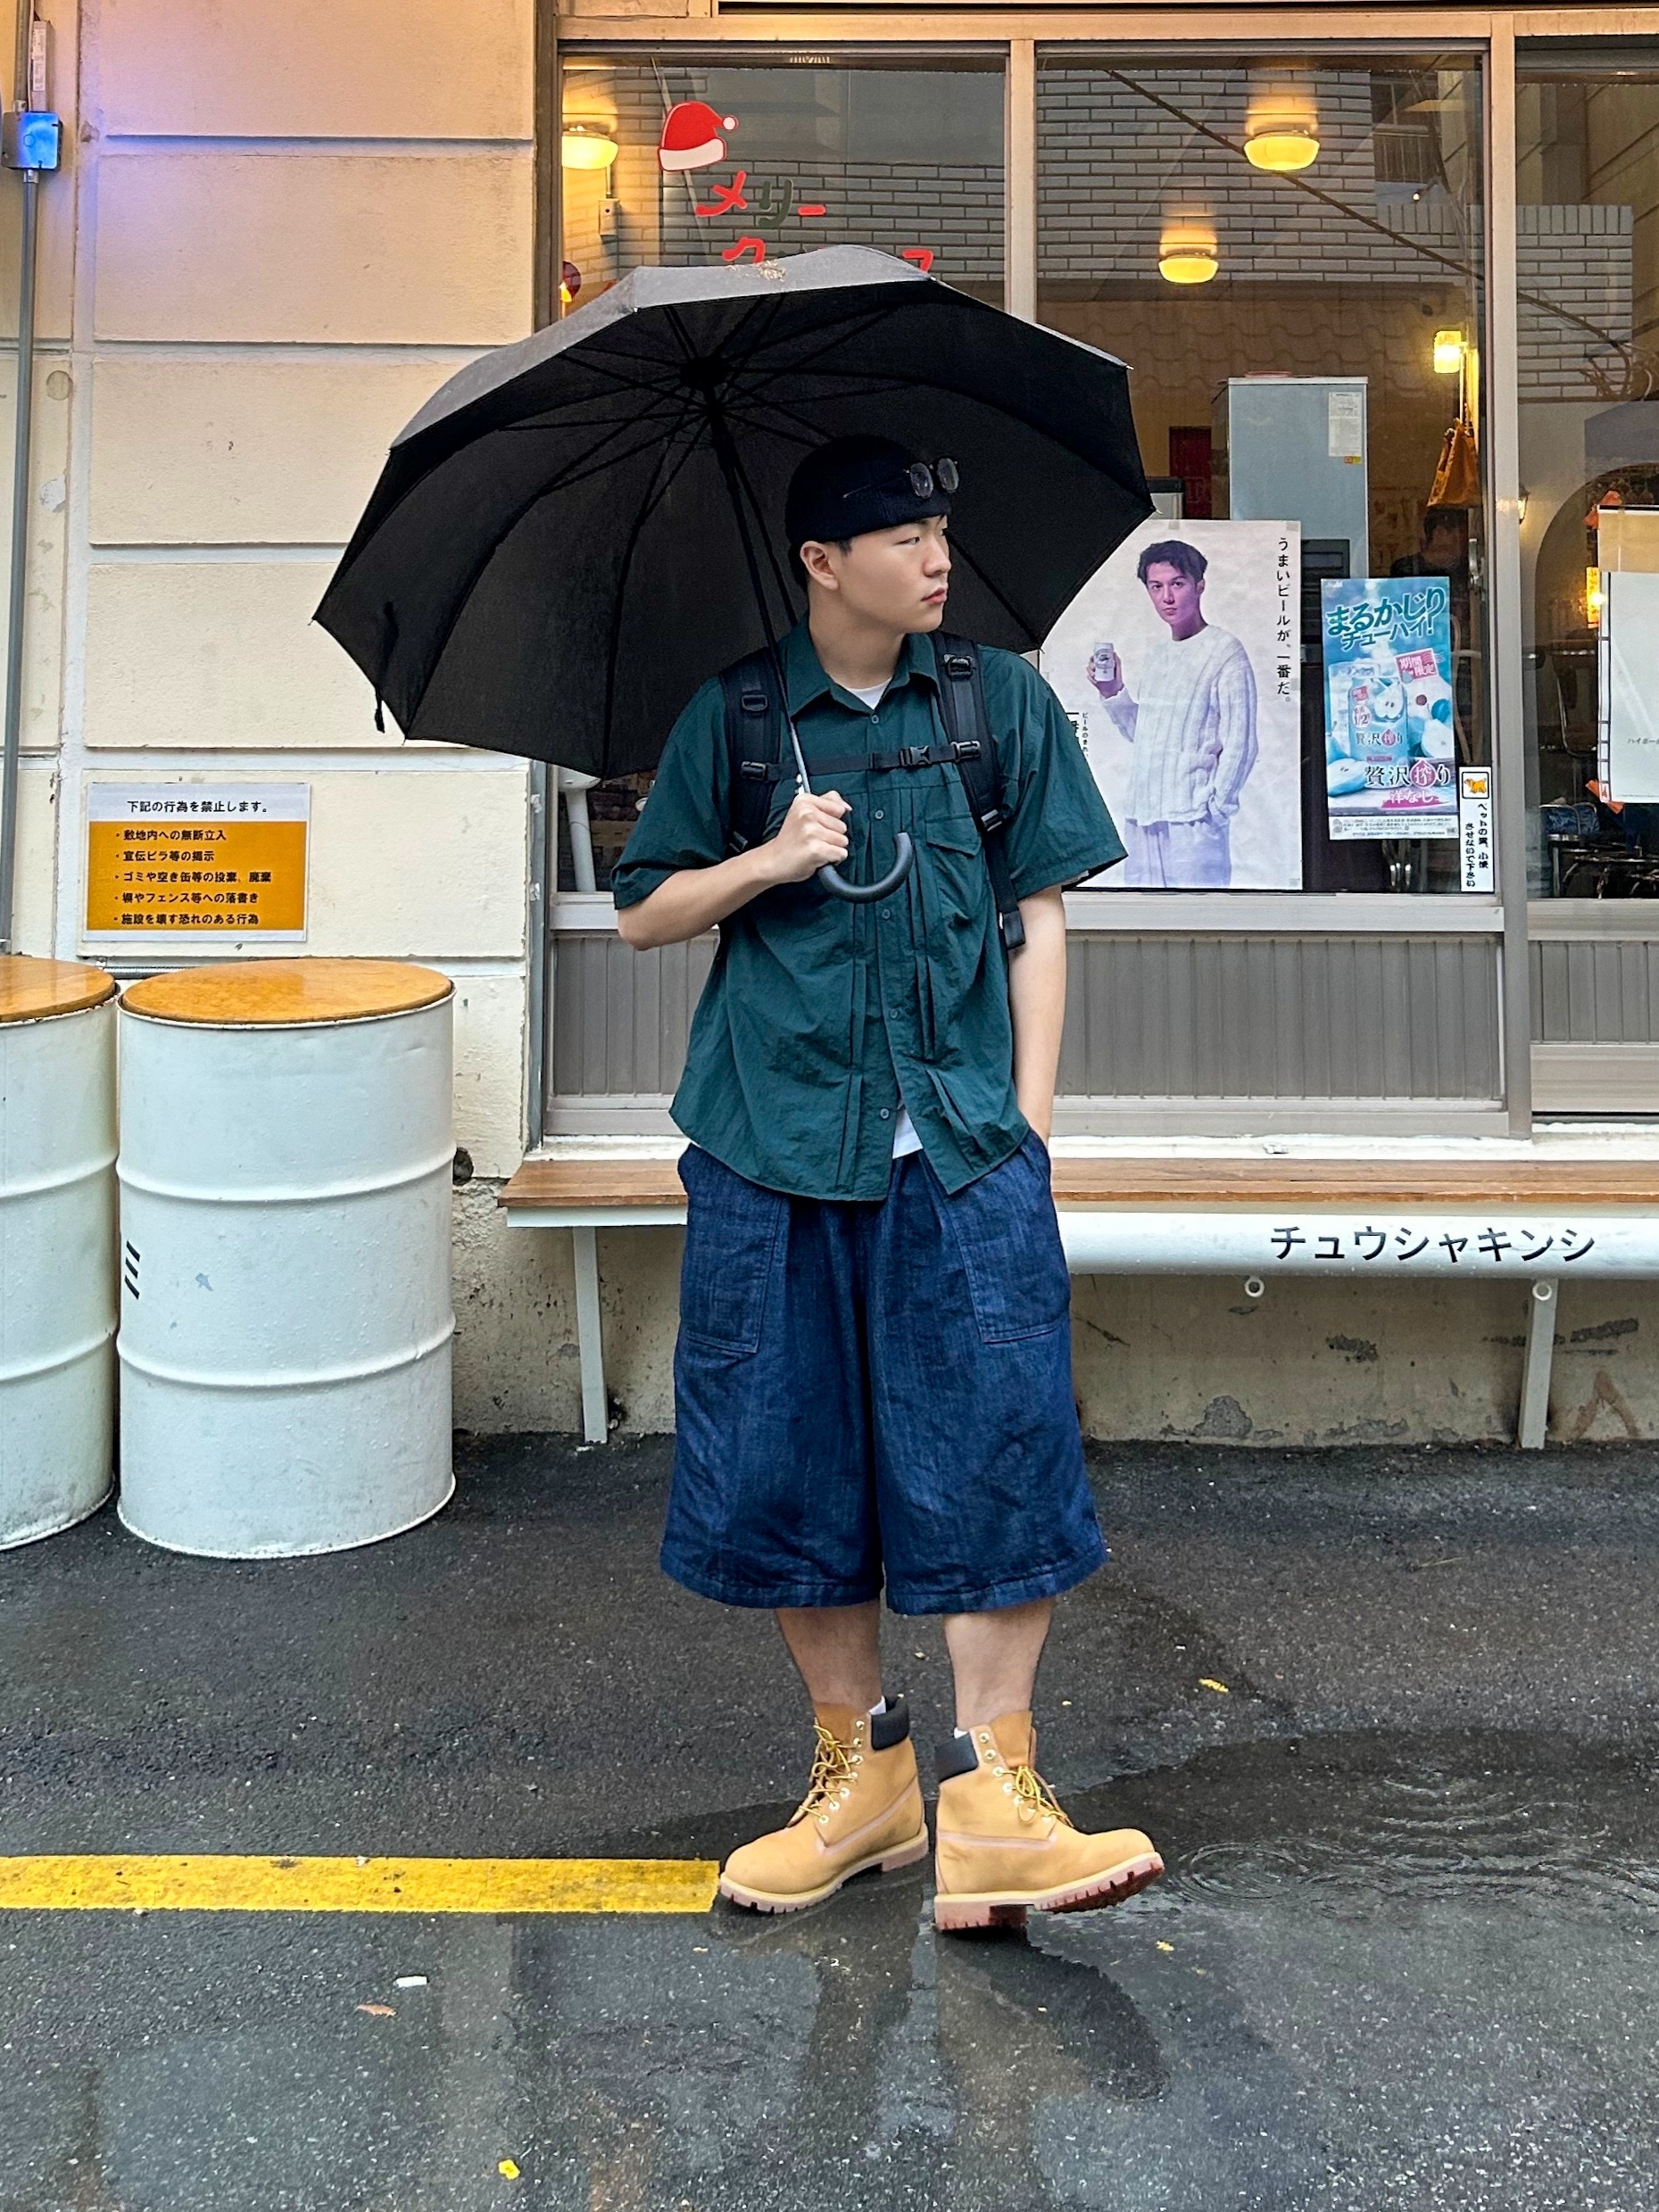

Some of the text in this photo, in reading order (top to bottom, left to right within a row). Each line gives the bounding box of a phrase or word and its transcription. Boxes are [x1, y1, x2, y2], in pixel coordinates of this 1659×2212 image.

[695, 170, 826, 229] メリー
[1276, 537, 1291, 702] うまいビールが、一番だ。
[1327, 587, 1445, 635] まるかじり
[1365, 764, 1450, 786] 贅沢搾り
[127, 800, 268, 813] 下記の行為を禁止します。
[1389, 790, 1435, 804] 洋なし
[1465, 823, 1476, 887] させないで下さい
[1271, 1225, 1595, 1263] チュウシャキンシ
